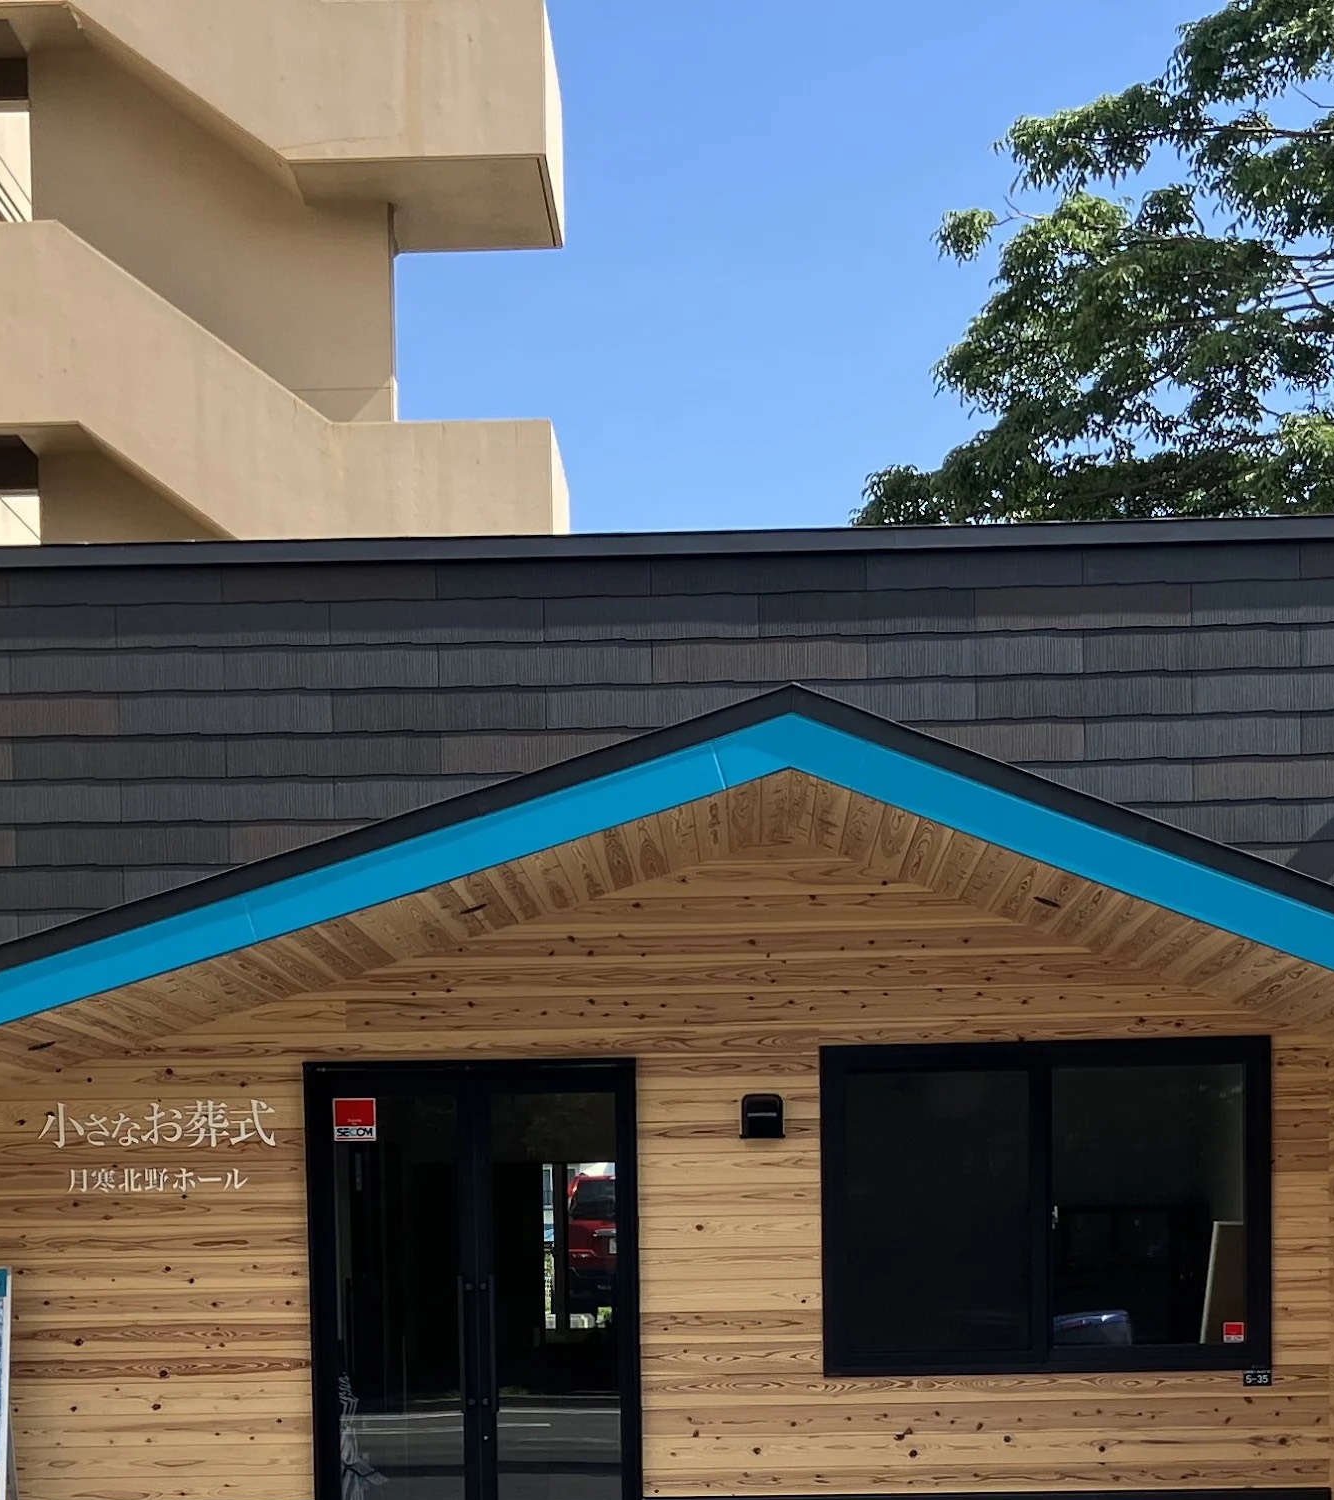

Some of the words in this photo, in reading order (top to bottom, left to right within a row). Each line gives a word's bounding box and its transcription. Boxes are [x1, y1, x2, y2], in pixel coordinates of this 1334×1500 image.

[38, 1098, 276, 1149] 小さなお葬式
[336, 1127, 373, 1137] SECOM
[67, 1167, 249, 1193] 月寒北野ホール
[1245, 1374, 1268, 1383] 5-35
